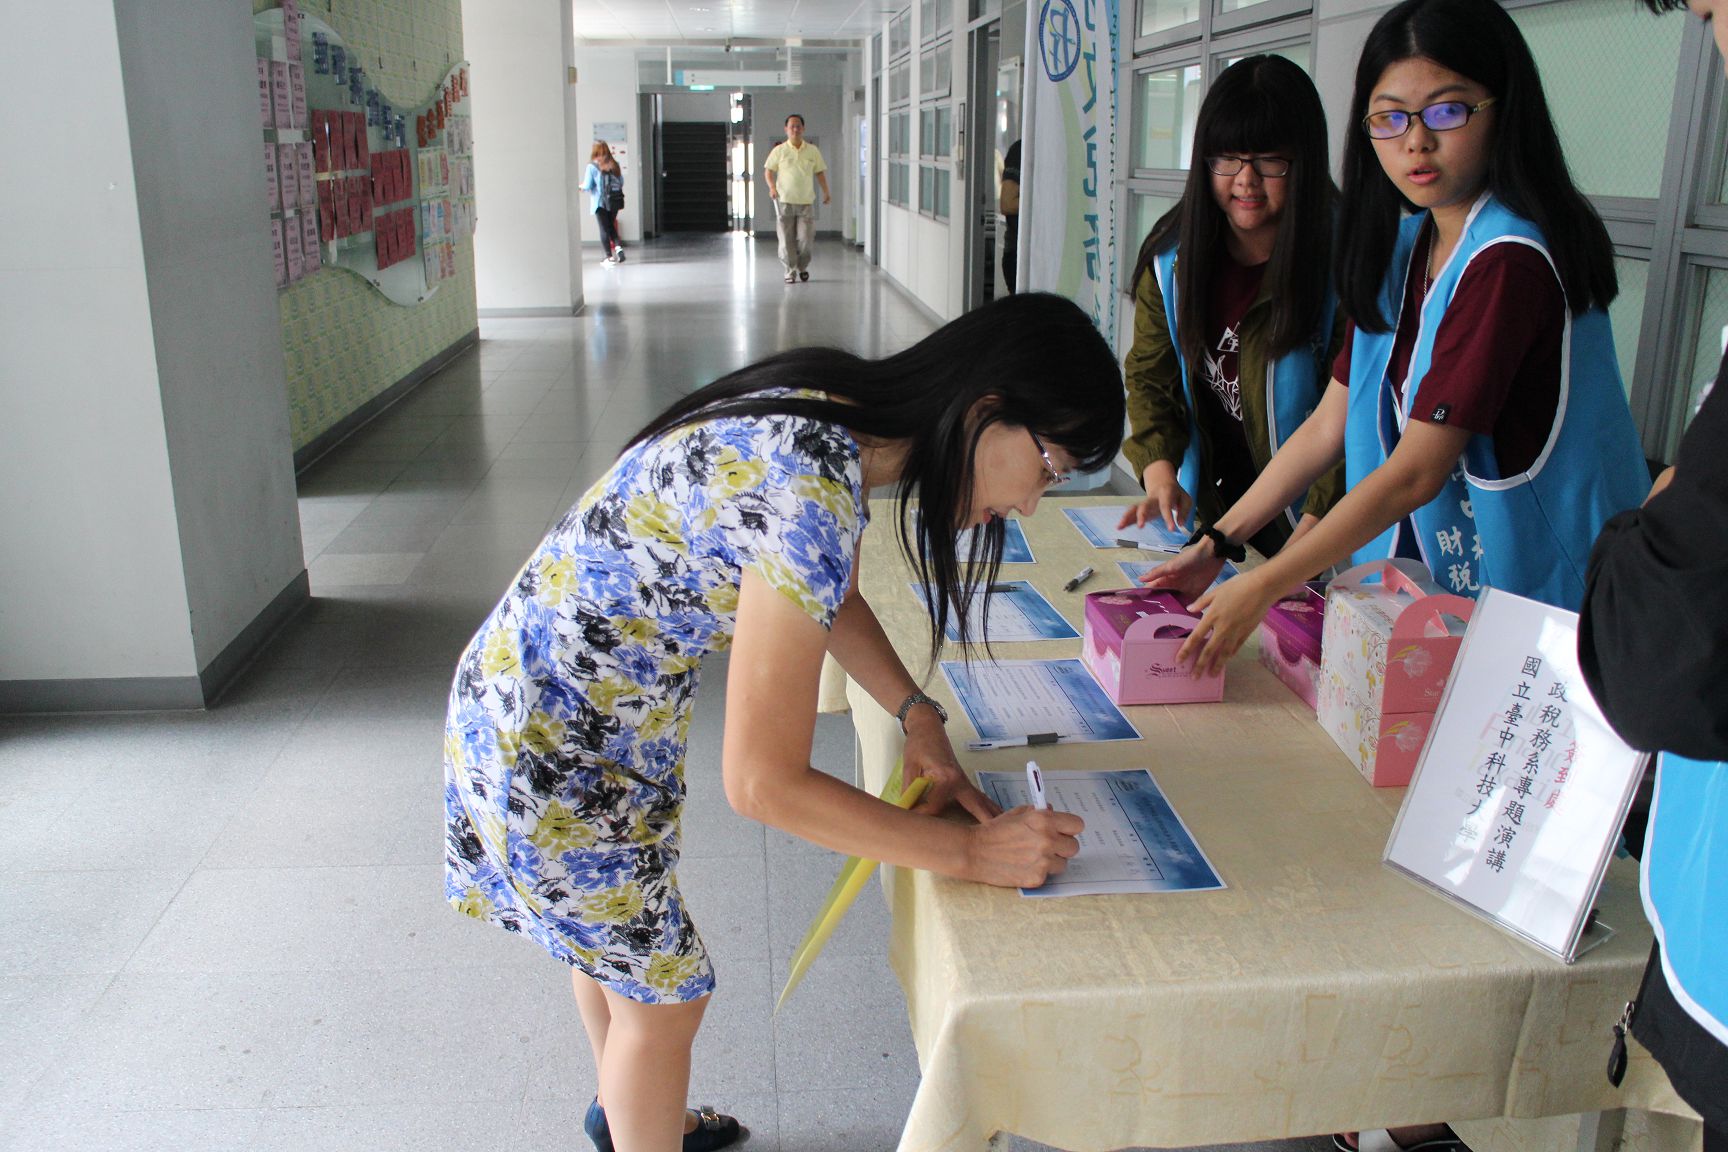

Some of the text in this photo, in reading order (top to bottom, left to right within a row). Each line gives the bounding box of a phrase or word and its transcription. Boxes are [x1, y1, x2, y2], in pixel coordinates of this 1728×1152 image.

[1435, 526, 1480, 600] 財稅
[1458, 655, 1542, 843] 國立臺中科技大學
[1485, 663, 1574, 874] 政稅務系專題演講
